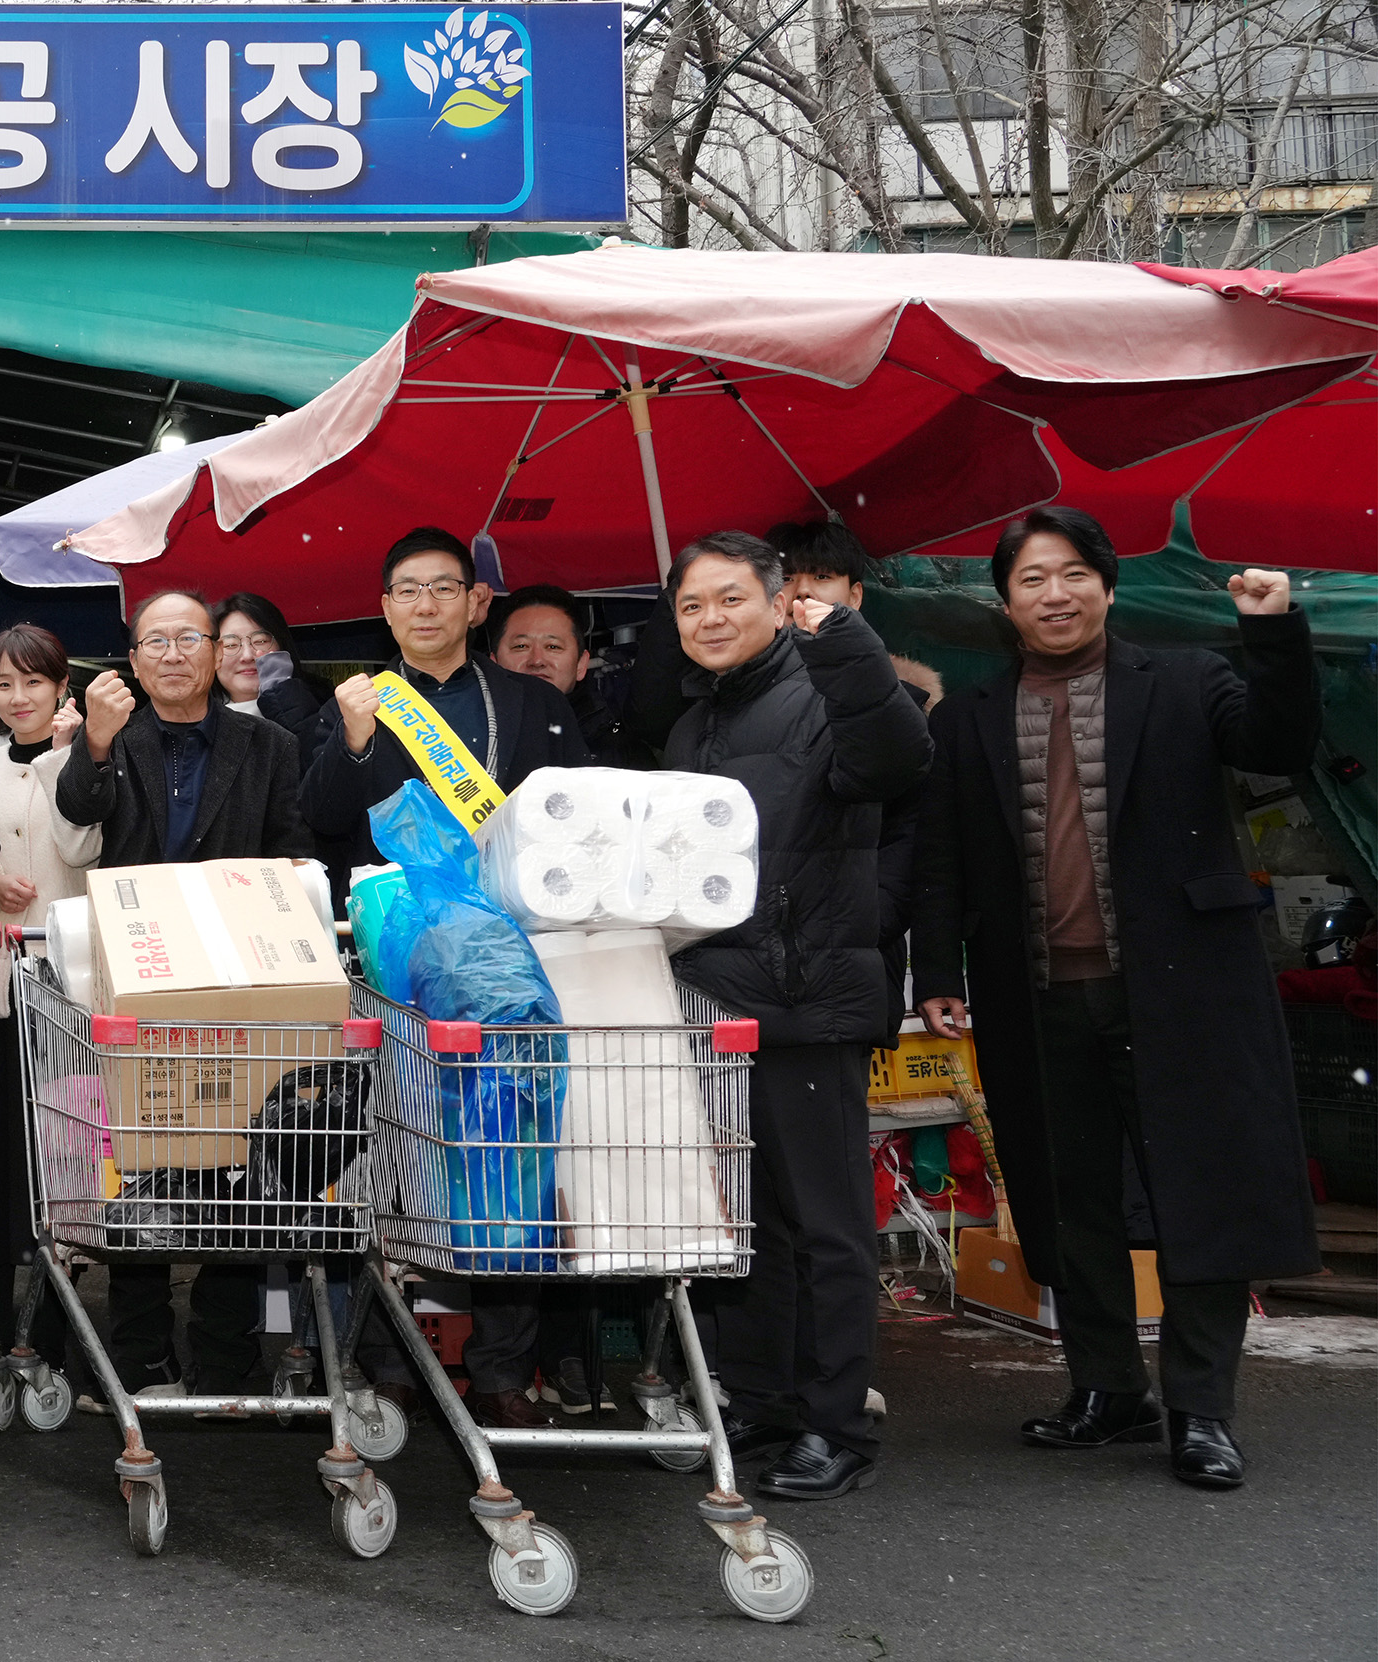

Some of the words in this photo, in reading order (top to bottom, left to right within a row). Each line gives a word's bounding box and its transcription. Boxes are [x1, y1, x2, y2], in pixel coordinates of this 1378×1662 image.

[104, 39, 377, 191] 시장
[377, 685, 482, 804] 온누리상품권을
[130, 936, 174, 979] 상생김
